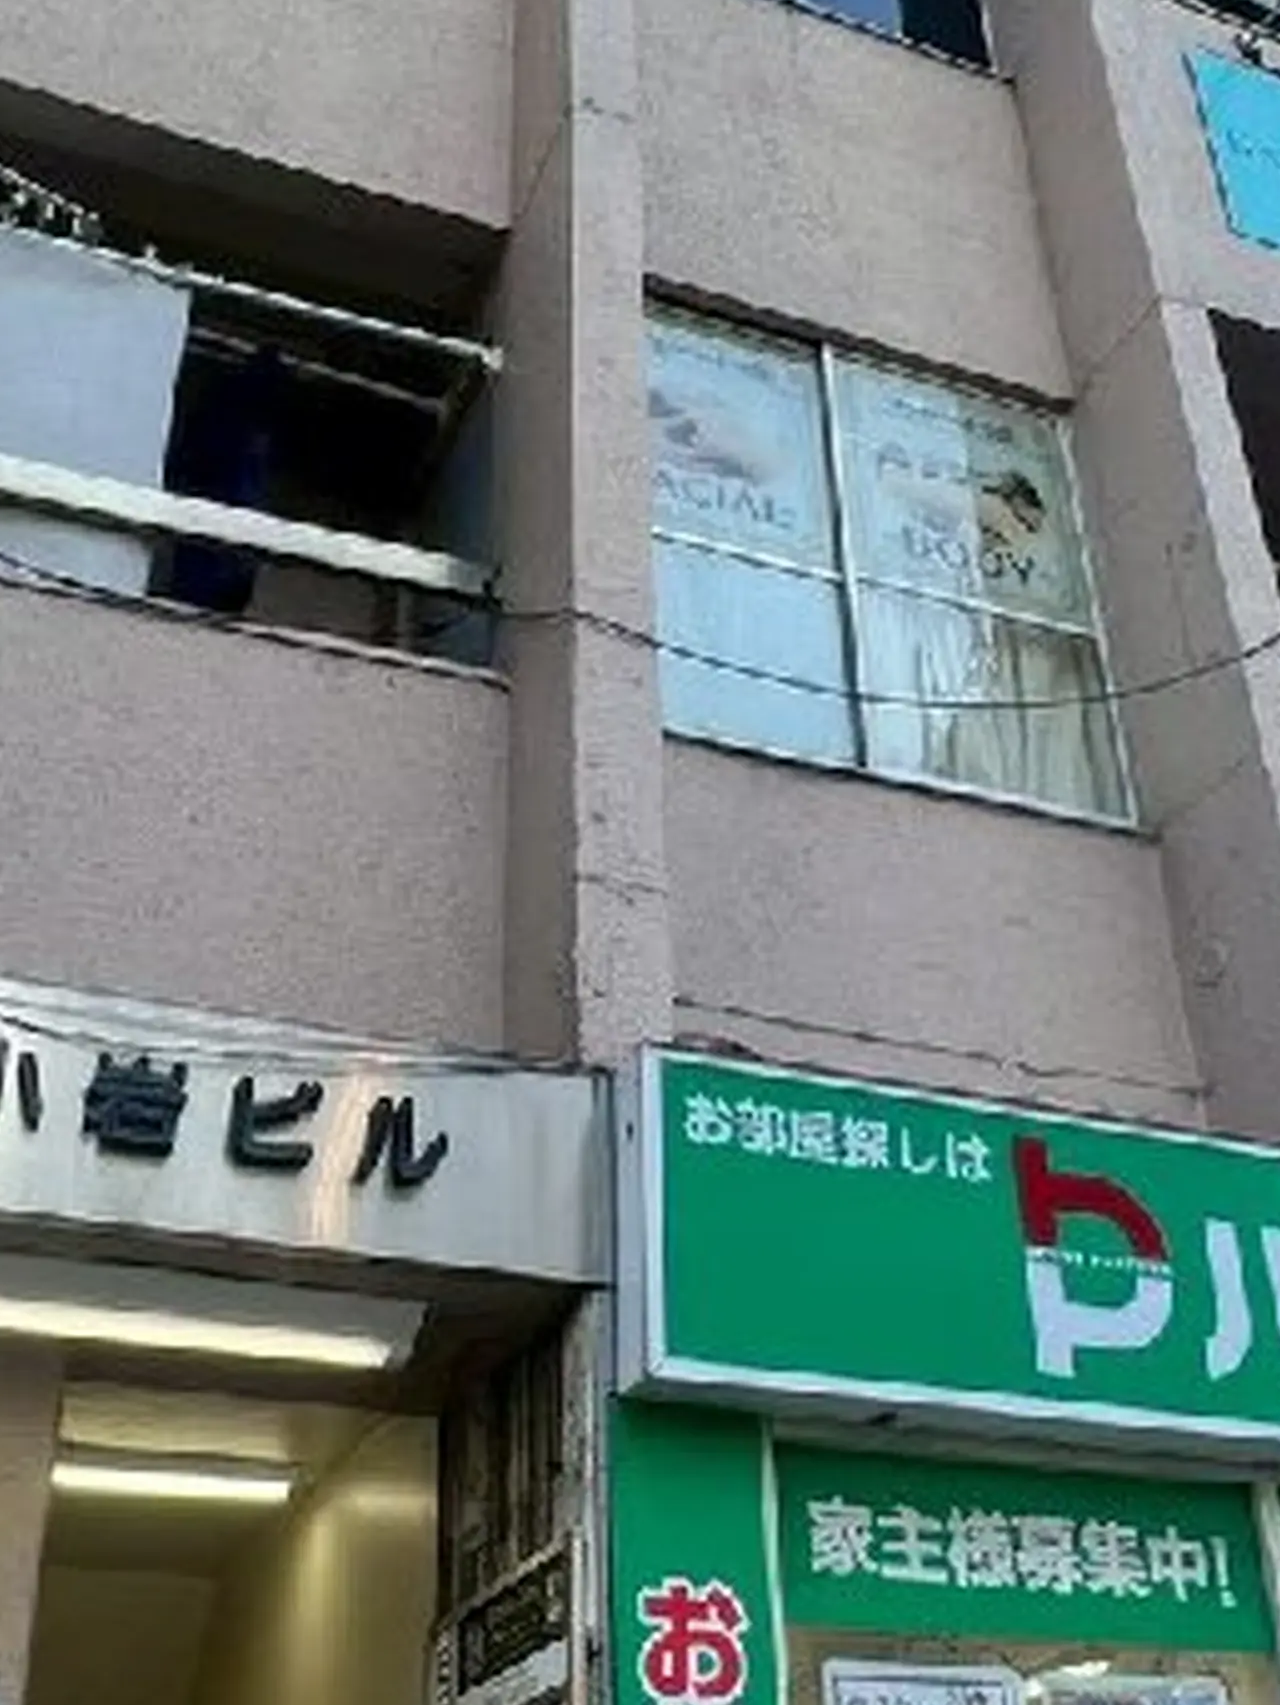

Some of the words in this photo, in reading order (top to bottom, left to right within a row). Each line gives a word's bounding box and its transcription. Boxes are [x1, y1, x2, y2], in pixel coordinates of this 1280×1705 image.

[683, 1092, 991, 1182] お部屋探しは
